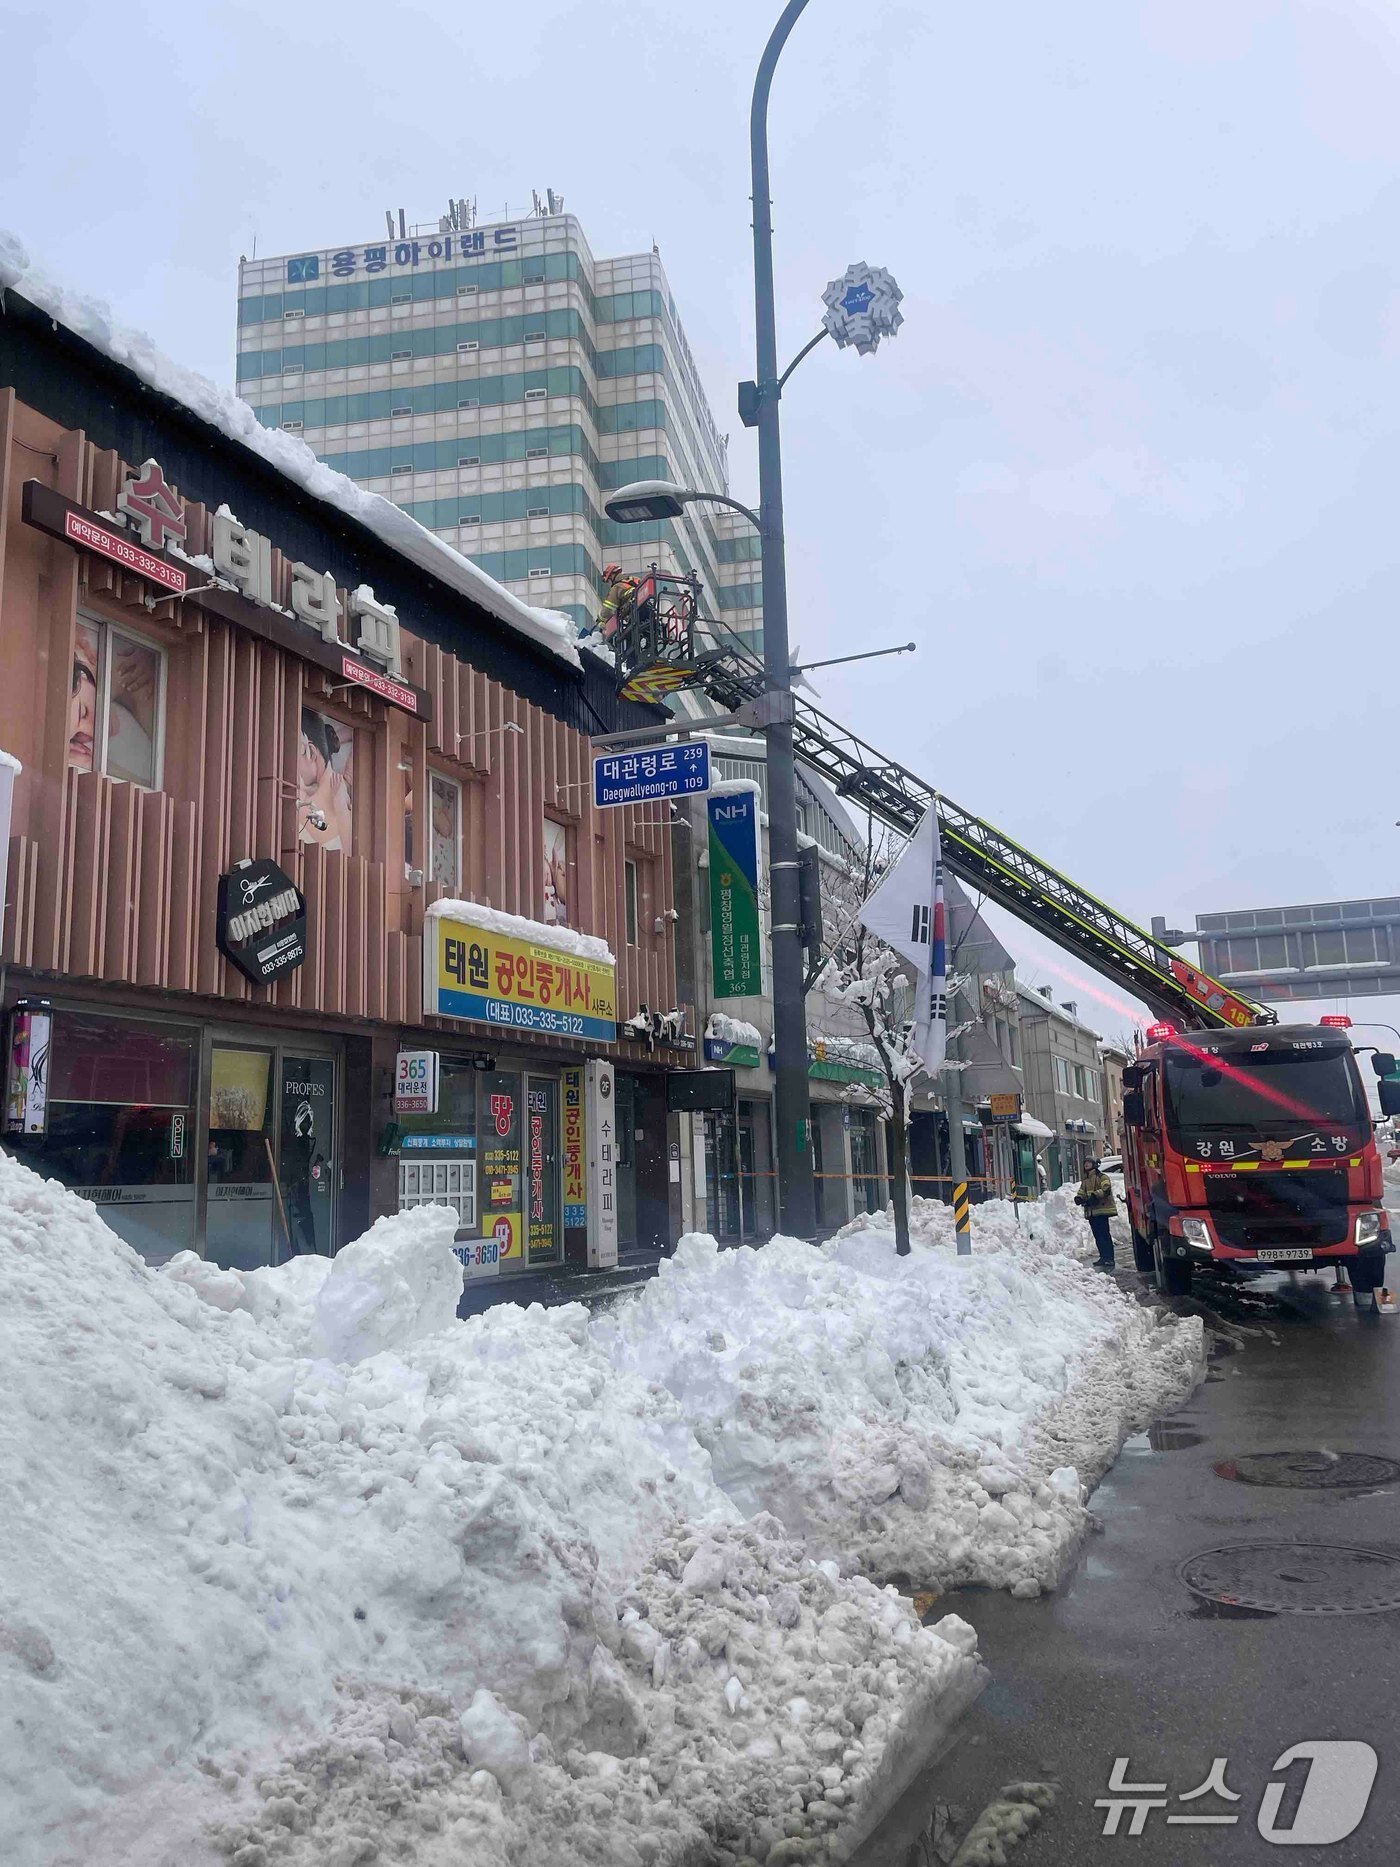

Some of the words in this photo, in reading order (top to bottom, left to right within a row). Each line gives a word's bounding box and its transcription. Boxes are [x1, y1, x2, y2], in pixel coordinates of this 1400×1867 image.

[331, 227, 518, 278] 용평하이랜드
[71, 519, 110, 550] 예약문의
[117, 545, 182, 586] 033-332-3133
[116, 458, 401, 673] 수테라피
[603, 752, 677, 780] 대관령로
[684, 747, 703, 761] 239
[603, 780, 678, 802] Daegwallyeong-ro
[684, 776, 703, 789] 109
[715, 804, 747, 821] NH
[444, 937, 489, 990] 태원
[494, 950, 591, 1011] 공인중개사
[591, 997, 613, 1017] 사무소
[729, 981, 747, 993] 365
[713, 1045, 723, 1055] NH
[399, 1059, 426, 1079] 365
[285, 1081, 325, 1097] PROFES
[397, 1081, 427, 1094] 대리운전
[601, 1081, 609, 1092] 2F
[396, 1100, 427, 1109] 336-3650
[527, 1090, 547, 1112] 태원
[490, 1094, 513, 1137] 땅
[173, 1117, 182, 1155] OPEN
[1196, 1140, 1234, 1158] 강원
[1310, 1136, 1348, 1152] 소방
[531, 1116, 543, 1222] 공인중개사
[600, 1120, 613, 1212] 수테라피
[564, 1206, 585, 1216] 335
[564, 1217, 585, 1227] 5122
